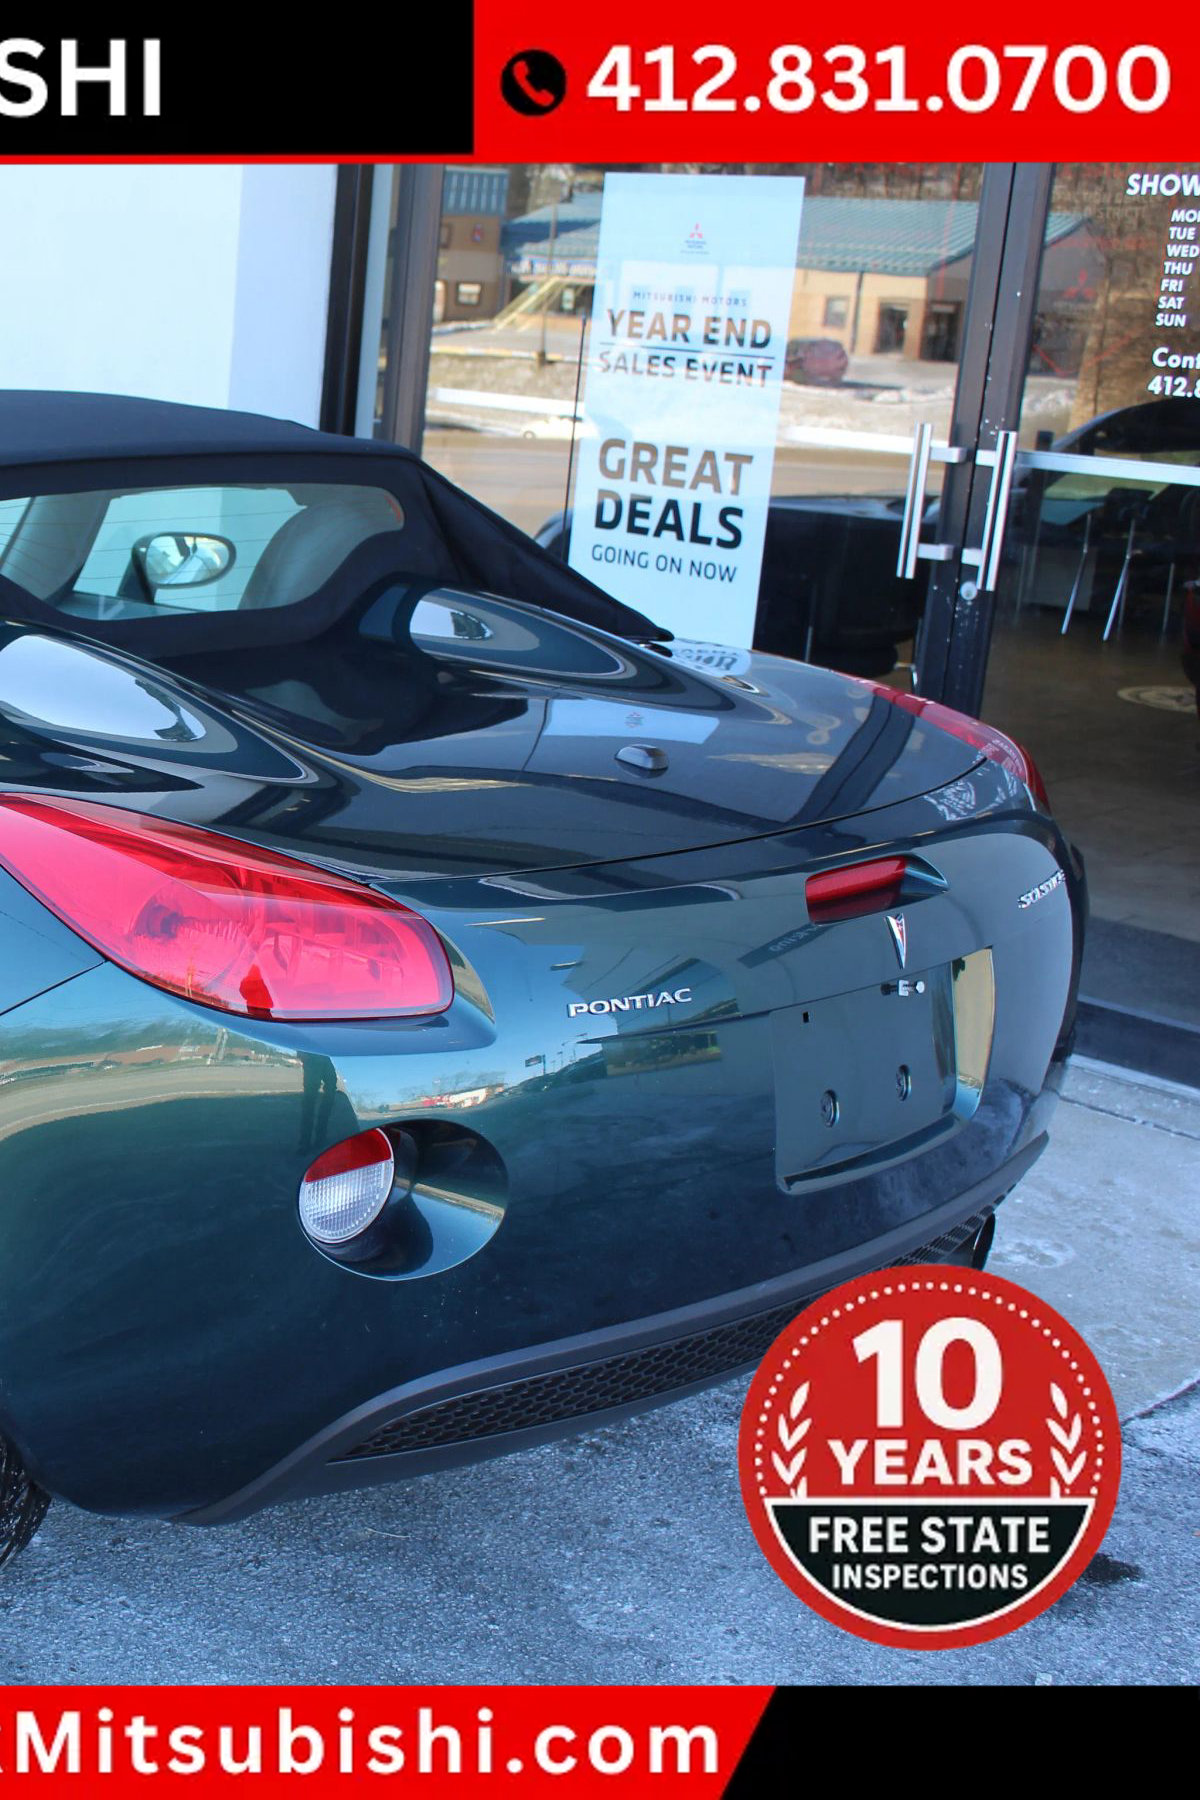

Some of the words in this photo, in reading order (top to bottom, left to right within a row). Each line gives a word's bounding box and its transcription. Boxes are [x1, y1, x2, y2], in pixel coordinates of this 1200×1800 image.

[1169, 226, 1196, 241] TUE
[1166, 244, 1200, 258] WED
[1163, 261, 1193, 276] THU
[1160, 278, 1184, 292] FRI
[633, 291, 696, 304] MITSUBISHI
[701, 296, 748, 308] MOTORS
[1157, 296, 1185, 310] SAT
[1155, 312, 1187, 328] SUN
[607, 308, 692, 344] YEAR
[702, 315, 773, 350] END
[599, 349, 676, 378] SALES
[684, 357, 773, 389] EVENT
[598, 438, 754, 497] GREAT
[594, 488, 744, 551] DEALS
[591, 544, 650, 570] GOING
[655, 554, 683, 575] ON
[689, 559, 738, 584] NOW
[567, 988, 693, 1018] PONTIAC
